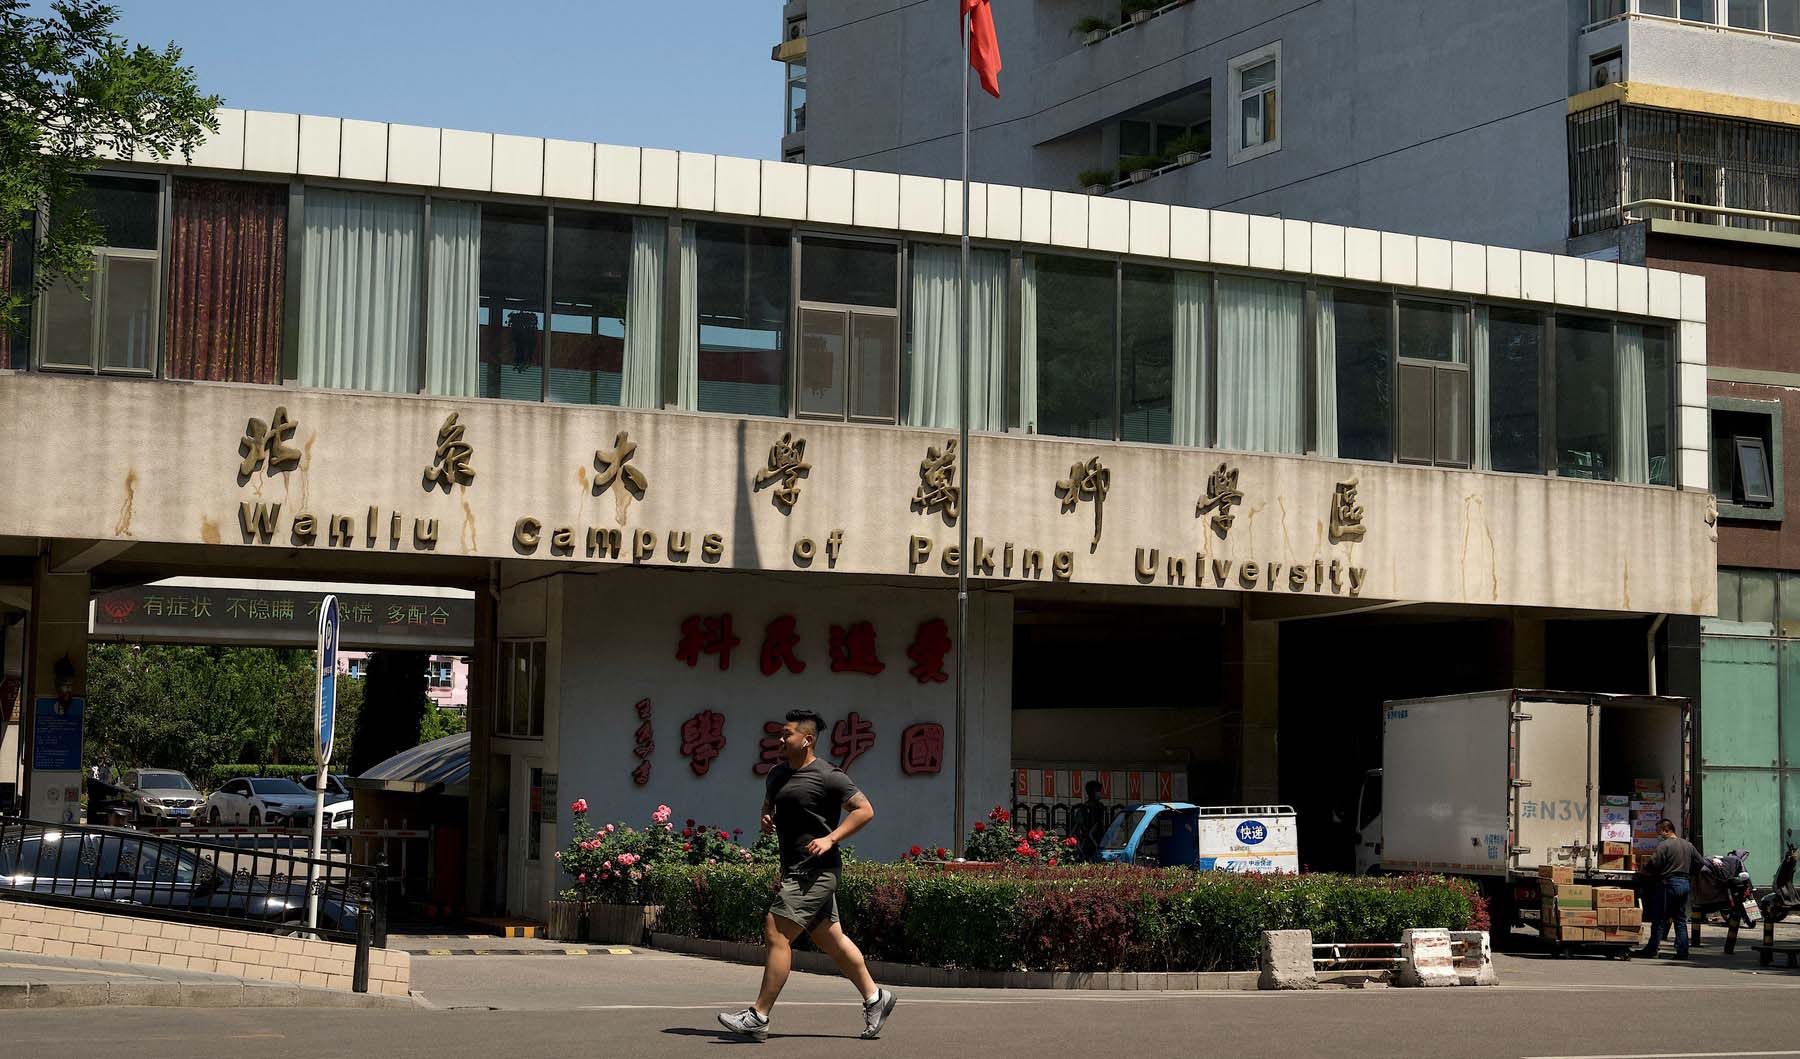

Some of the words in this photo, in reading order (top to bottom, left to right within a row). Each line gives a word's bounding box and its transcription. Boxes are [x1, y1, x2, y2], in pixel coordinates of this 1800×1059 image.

[239, 501, 439, 548] Wanliu
[512, 515, 726, 565] Campus
[793, 529, 843, 567] of
[909, 534, 1074, 580] Peking
[1136, 546, 1369, 595] University
[143, 595, 212, 618] 有症状
[226, 597, 294, 621] 不隐瞒
[387, 603, 451, 626] 多配合
[1018, 770, 1026, 792] S
[1045, 775, 1053, 792] T
[1072, 773, 1081, 793] U
[1101, 774, 1110, 793] V
[1129, 774, 1139, 793] W
[1161, 776, 1171, 795] X
[1240, 825, 1264, 840] 快递
